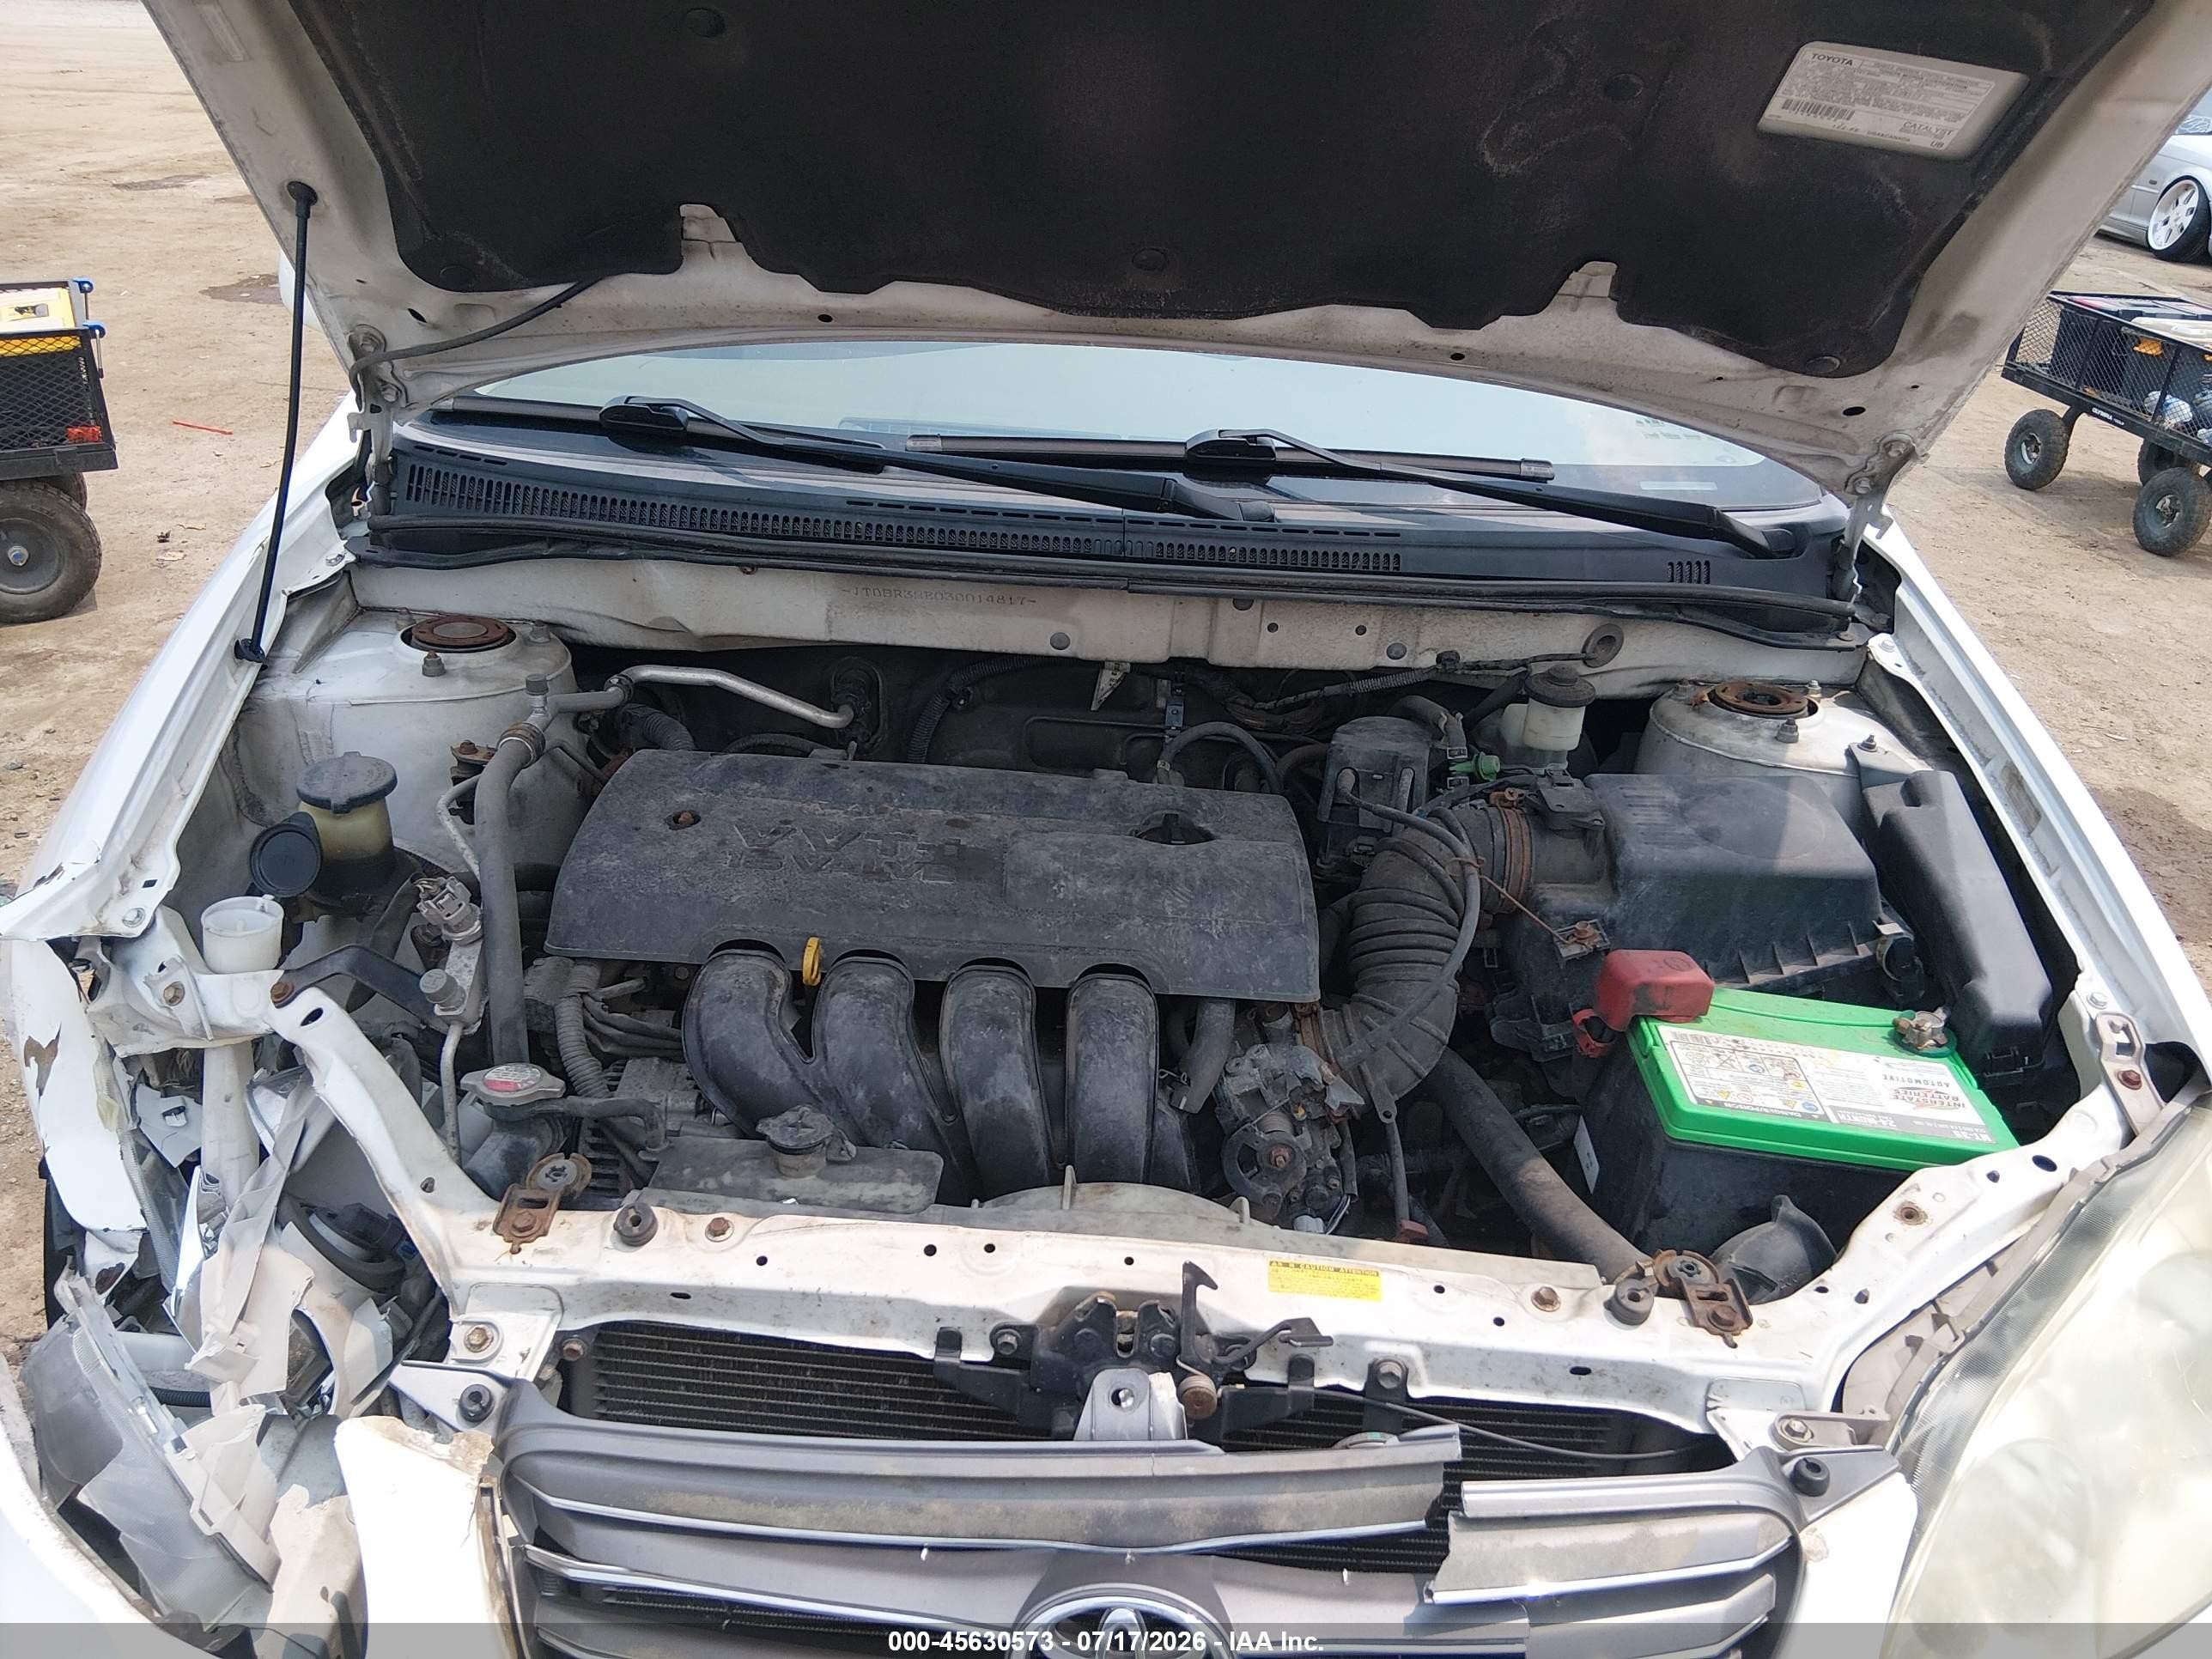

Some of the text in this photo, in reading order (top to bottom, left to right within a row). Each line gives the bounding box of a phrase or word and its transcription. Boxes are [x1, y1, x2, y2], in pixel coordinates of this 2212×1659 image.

[1811, 53, 1853, 66] TOYOTA
[1902, 121, 1954, 136] CATALYST
[1881, 1073, 1950, 1088] AUTOMOTIVE
[1892, 1094, 1966, 1109] INTERSTATE
[1893, 1089, 1960, 1102] BATTERIES
[1300, 1261, 1334, 1272] CAUTION
